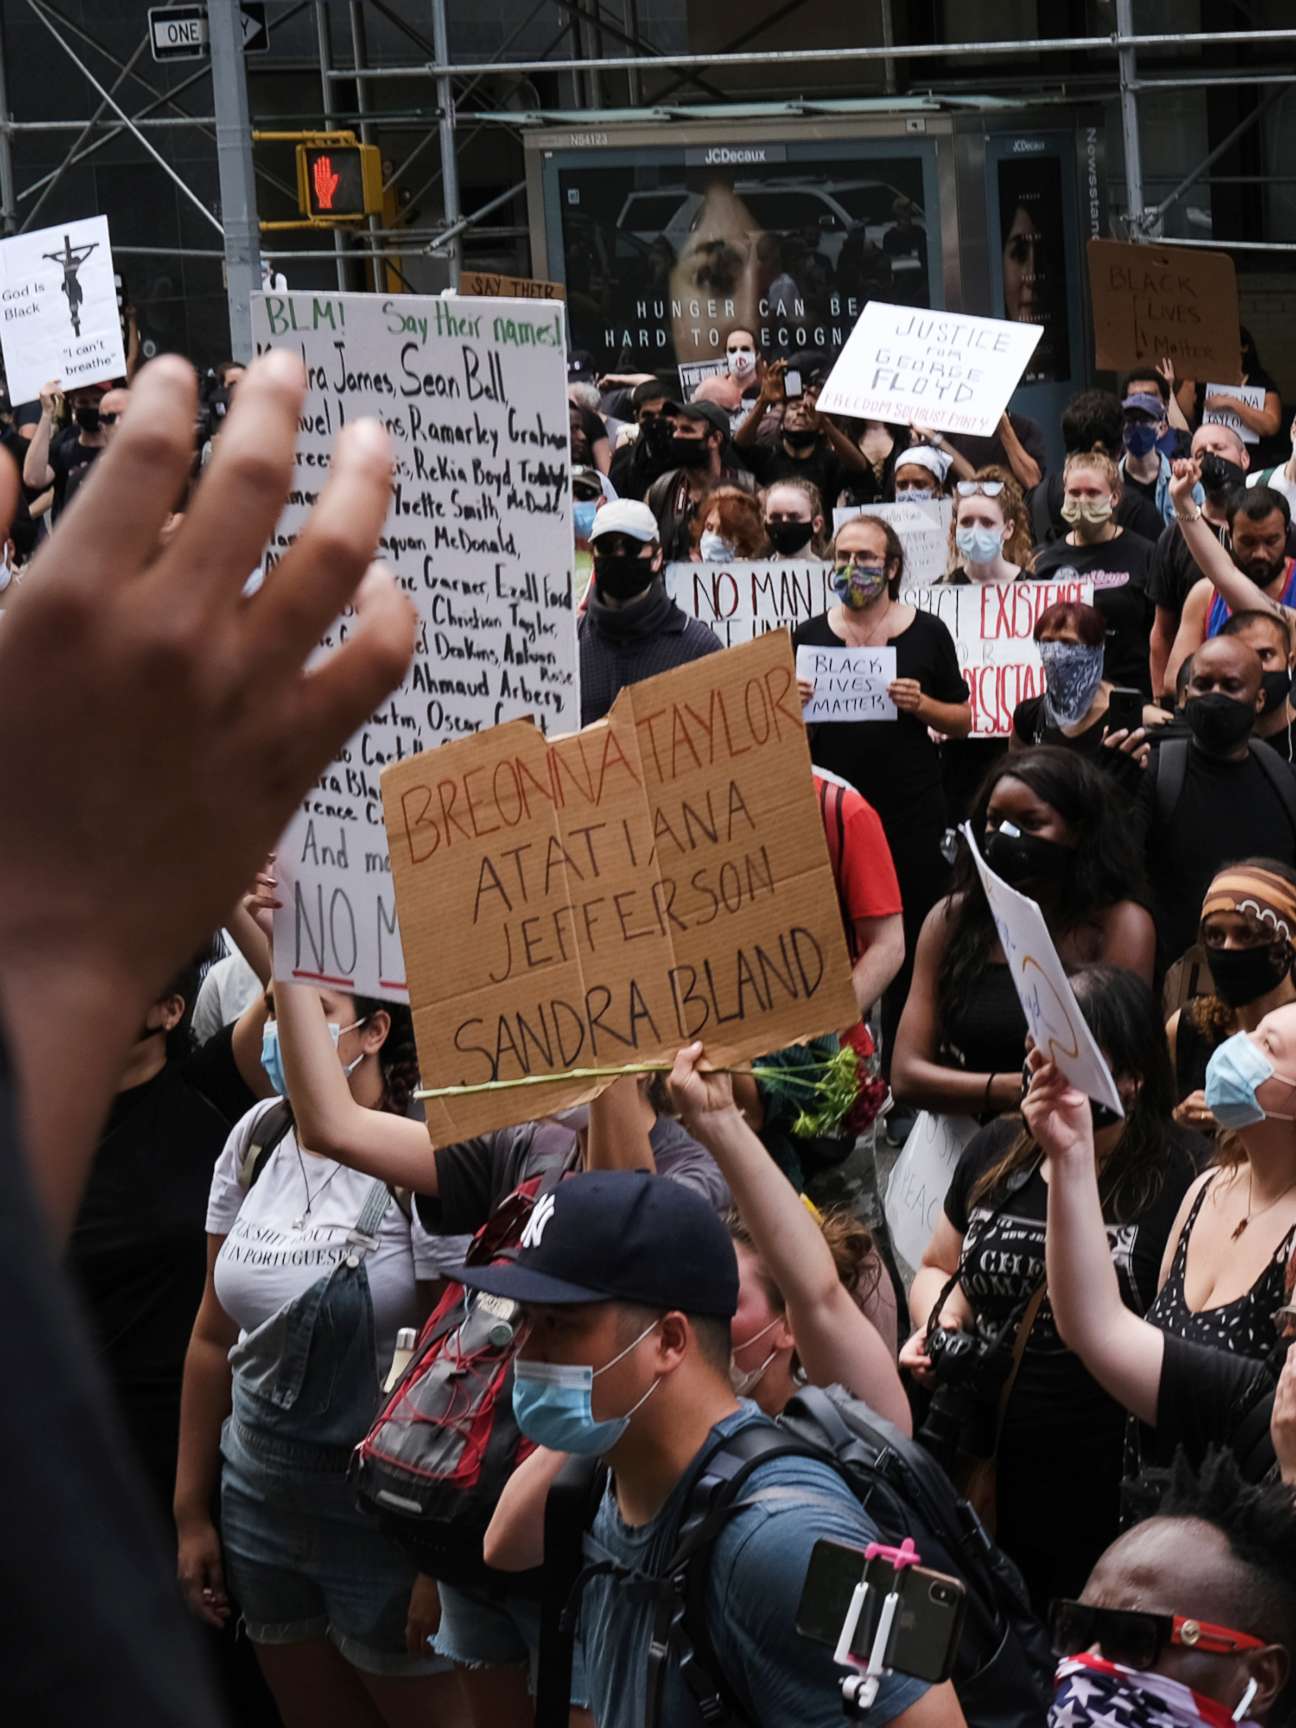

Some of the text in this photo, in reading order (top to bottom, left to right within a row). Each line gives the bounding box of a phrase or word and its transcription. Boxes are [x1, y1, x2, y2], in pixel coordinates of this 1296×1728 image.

[167, 22, 200, 44] ONE
[705, 148, 766, 164] JCDecaux
[2, 284, 30, 302] God
[471, 276, 554, 299] SAY THEIR
[1109, 265, 1199, 298] BLACK
[4, 302, 41, 322] Black
[264, 297, 562, 348] BLM! Say their names!
[636, 297, 858, 319] HUNGER CAN BE
[1147, 302, 1202, 325] LIVES
[604, 327, 842, 348] HARD TO ECOGN
[895, 315, 1012, 353] JUSTICE
[399, 341, 461, 398] Sean
[874, 347, 985, 383] GEORGE
[871, 367, 974, 404] FLOYD
[408, 402, 500, 457] Ramarley
[377, 535, 427, 561] aquan
[693, 570, 739, 621] NO
[752, 568, 812, 619] MAN
[808, 654, 883, 675] BLACK
[412, 661, 566, 713] Ahmaud Arbery
[813, 676, 876, 693] LIVES
[426, 700, 482, 732] Oscar
[812, 694, 886, 715] MATTER
[400, 664, 805, 866] BREONNA TAYLOR
[301, 819, 349, 869] And
[472, 779, 757, 925] ATATIANA
[294, 879, 358, 977] NO
[488, 845, 776, 984] JEFFERSON
[453, 926, 825, 1084] SANDRA BLAND
